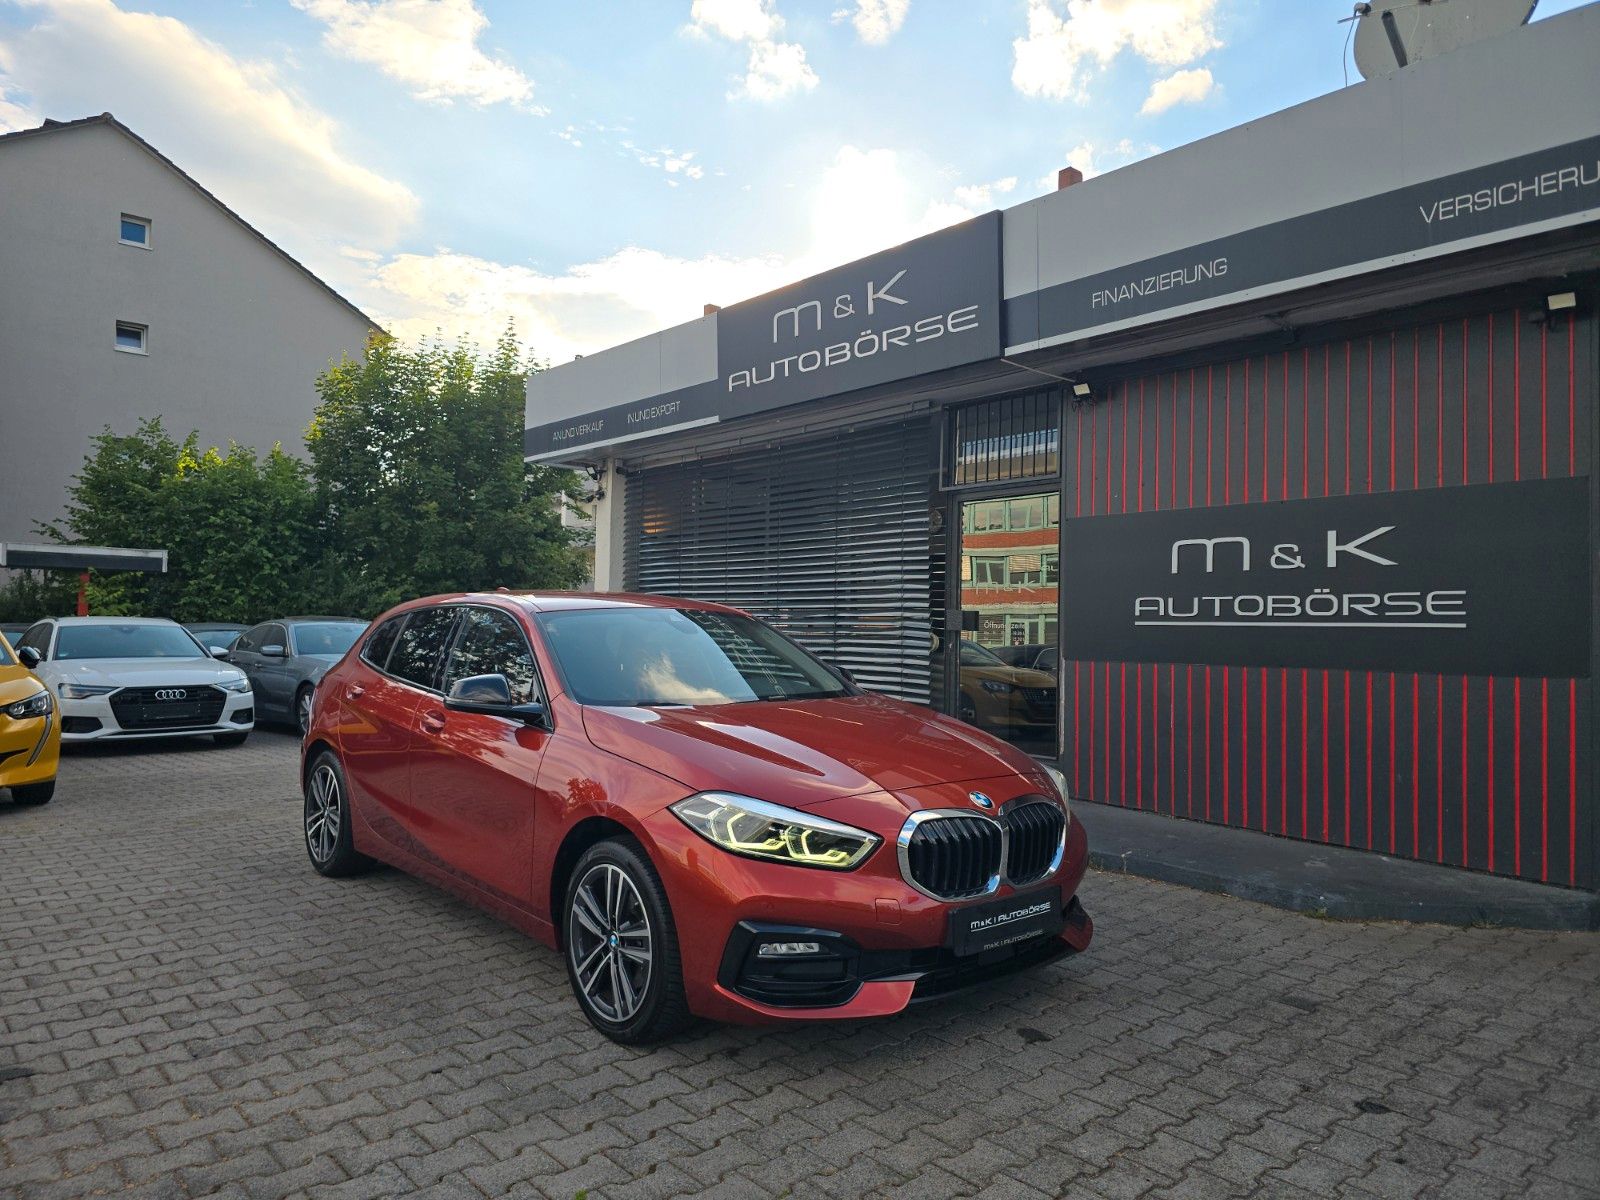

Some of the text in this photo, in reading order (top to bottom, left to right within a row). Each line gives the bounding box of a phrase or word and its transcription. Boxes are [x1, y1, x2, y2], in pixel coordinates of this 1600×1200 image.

[1419, 160, 1600, 224] VERSICHERU
[773, 269, 909, 344] M & K
[1092, 257, 1228, 309] FINANZIERUNG
[728, 304, 979, 392] AUTOBÖRSE
[1171, 525, 1399, 574] M & K
[1134, 588, 1467, 617] AUTOBÖRSE
[998, 902, 1051, 921] AUTOBÖRSE
